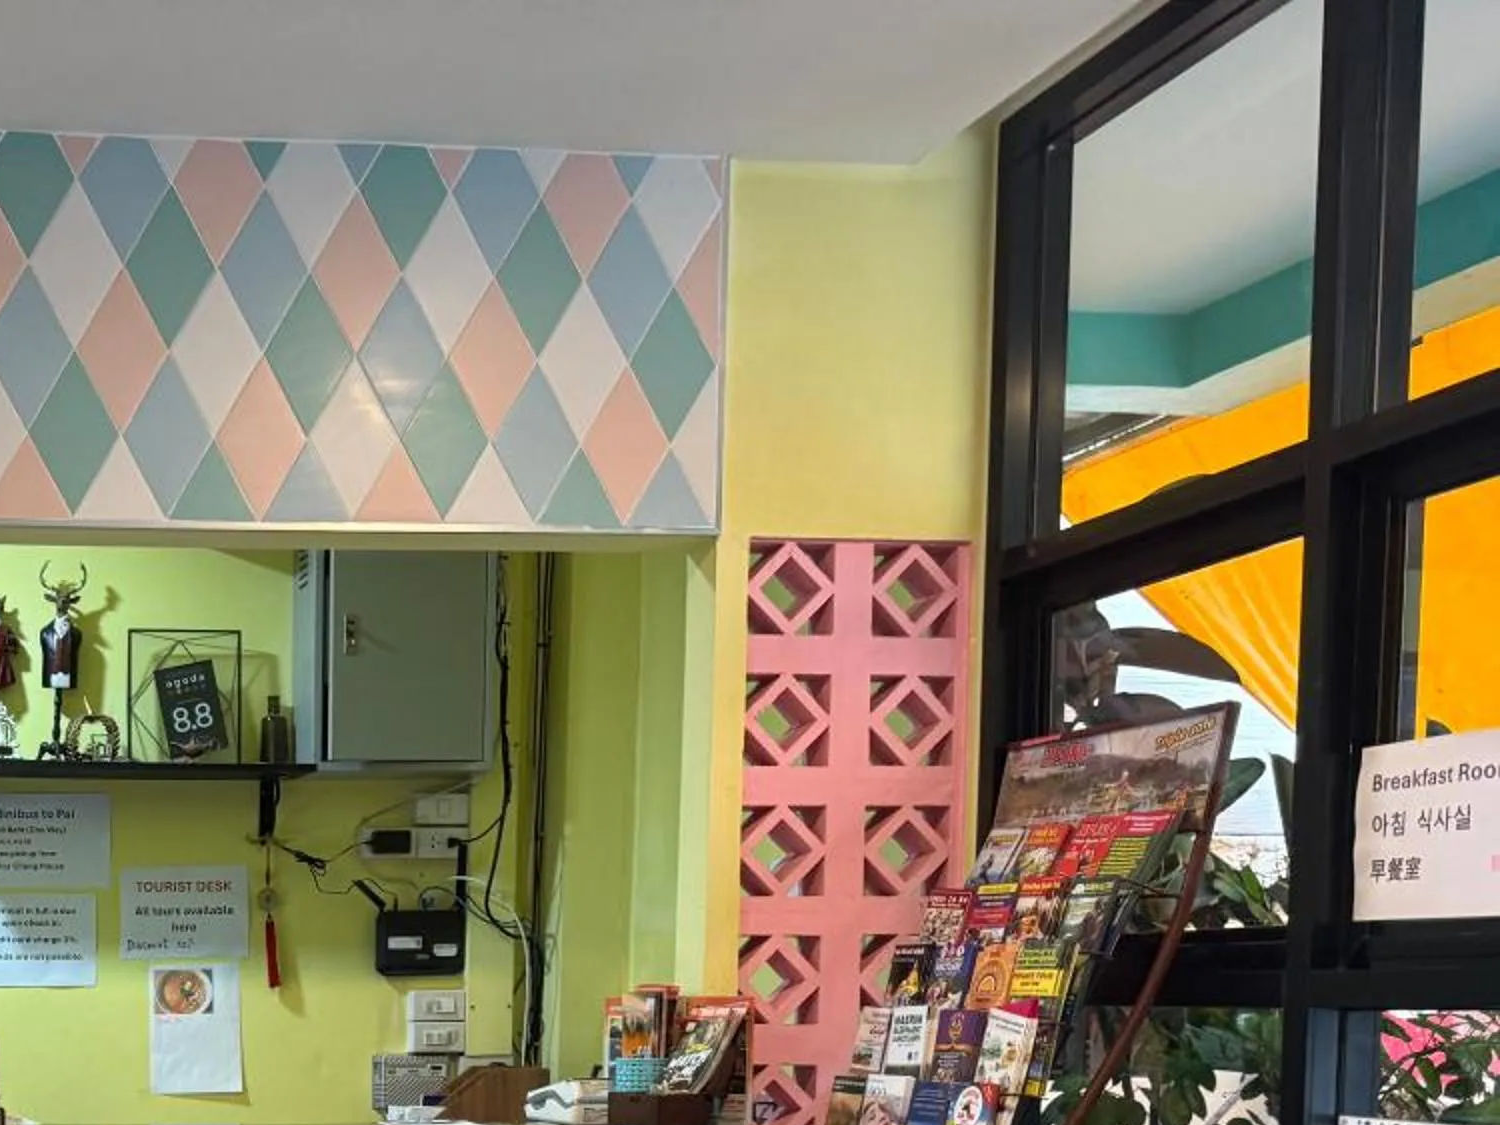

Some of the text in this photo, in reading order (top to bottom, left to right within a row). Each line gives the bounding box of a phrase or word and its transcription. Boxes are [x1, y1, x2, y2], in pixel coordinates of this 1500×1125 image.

[173, 702, 213, 733] 8.8
[1372, 763, 1500, 793] Breakfast Roo
[1372, 804, 1472, 838] 아침 식사실
[1370, 856, 1421, 883] 早餐室
[136, 880, 232, 892] TOURIST DESK
[171, 923, 197, 932] here
